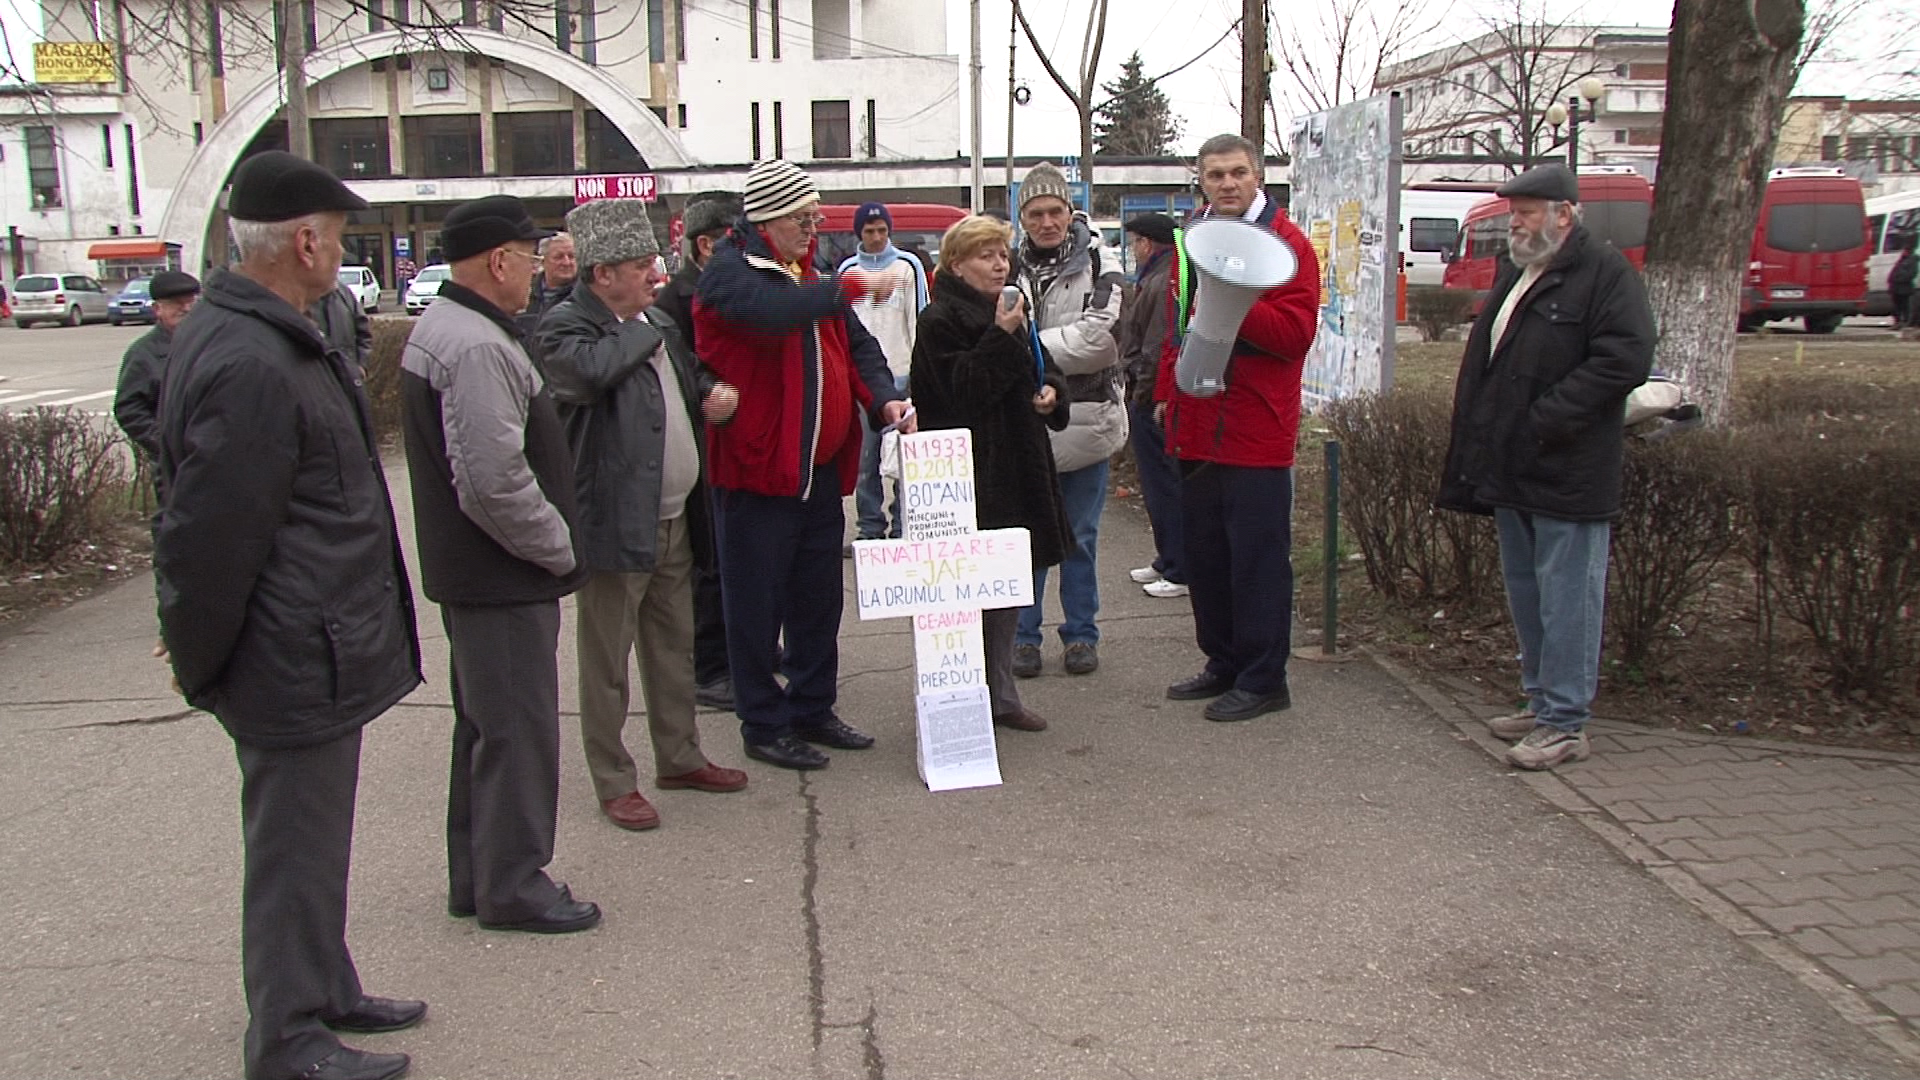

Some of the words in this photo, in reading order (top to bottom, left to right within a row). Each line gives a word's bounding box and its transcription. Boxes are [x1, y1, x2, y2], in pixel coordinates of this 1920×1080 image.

[36, 58, 73, 68] HONG
[578, 178, 606, 198] NON
[617, 177, 654, 196] STOP
[910, 526, 971, 541] COMUNISTE
[859, 539, 995, 567] PRIVATIZARE
[860, 588, 881, 608] LA
[885, 585, 946, 607] DRUMUL
[956, 579, 1020, 601] MARE
[931, 630, 967, 651] TOT
[941, 652, 968, 668] AM
[920, 668, 982, 688] PIERDUT
